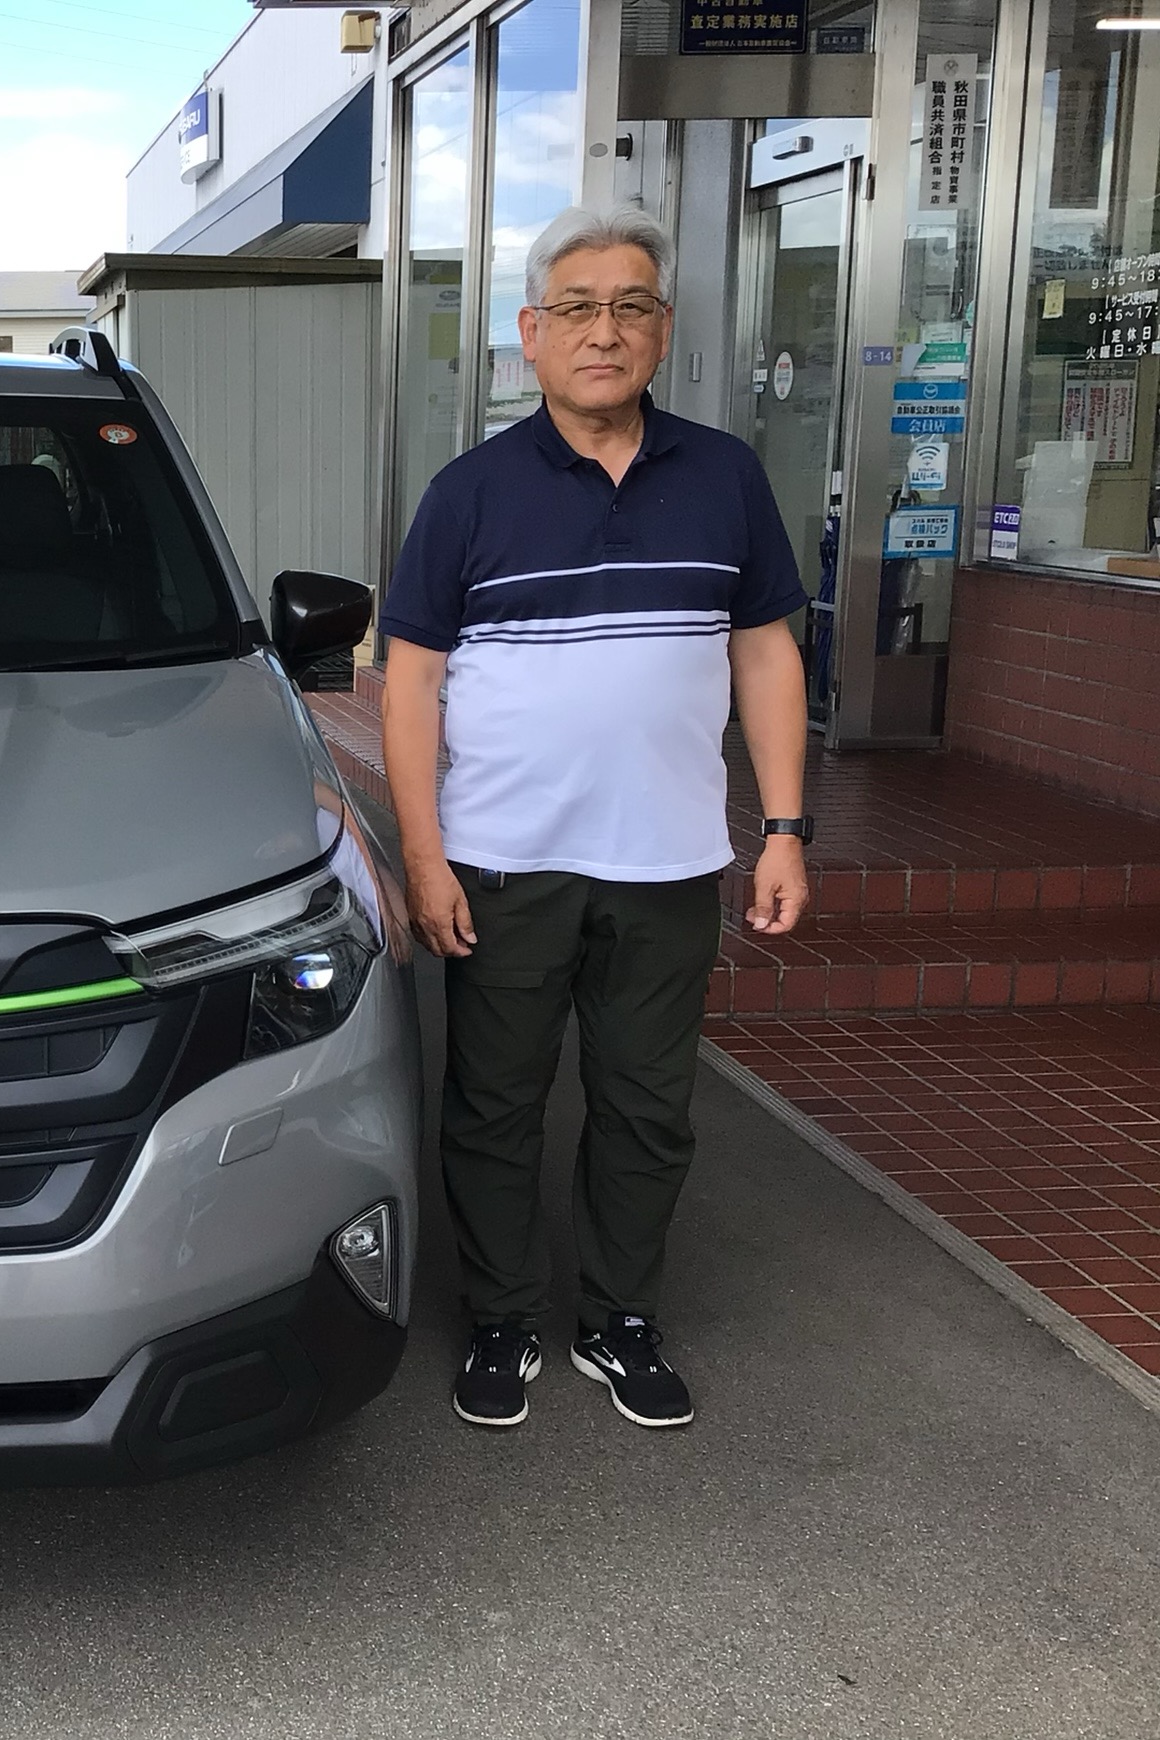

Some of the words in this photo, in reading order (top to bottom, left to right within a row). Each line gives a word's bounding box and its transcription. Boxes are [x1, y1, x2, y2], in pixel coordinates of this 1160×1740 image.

[691, 14, 798, 29] 査定業務実施店
[928, 80, 947, 164] 職員共済組合
[950, 80, 969, 164] 秋田県市町村
[865, 351, 892, 361] 8-14
[908, 418, 946, 432] 会員店
